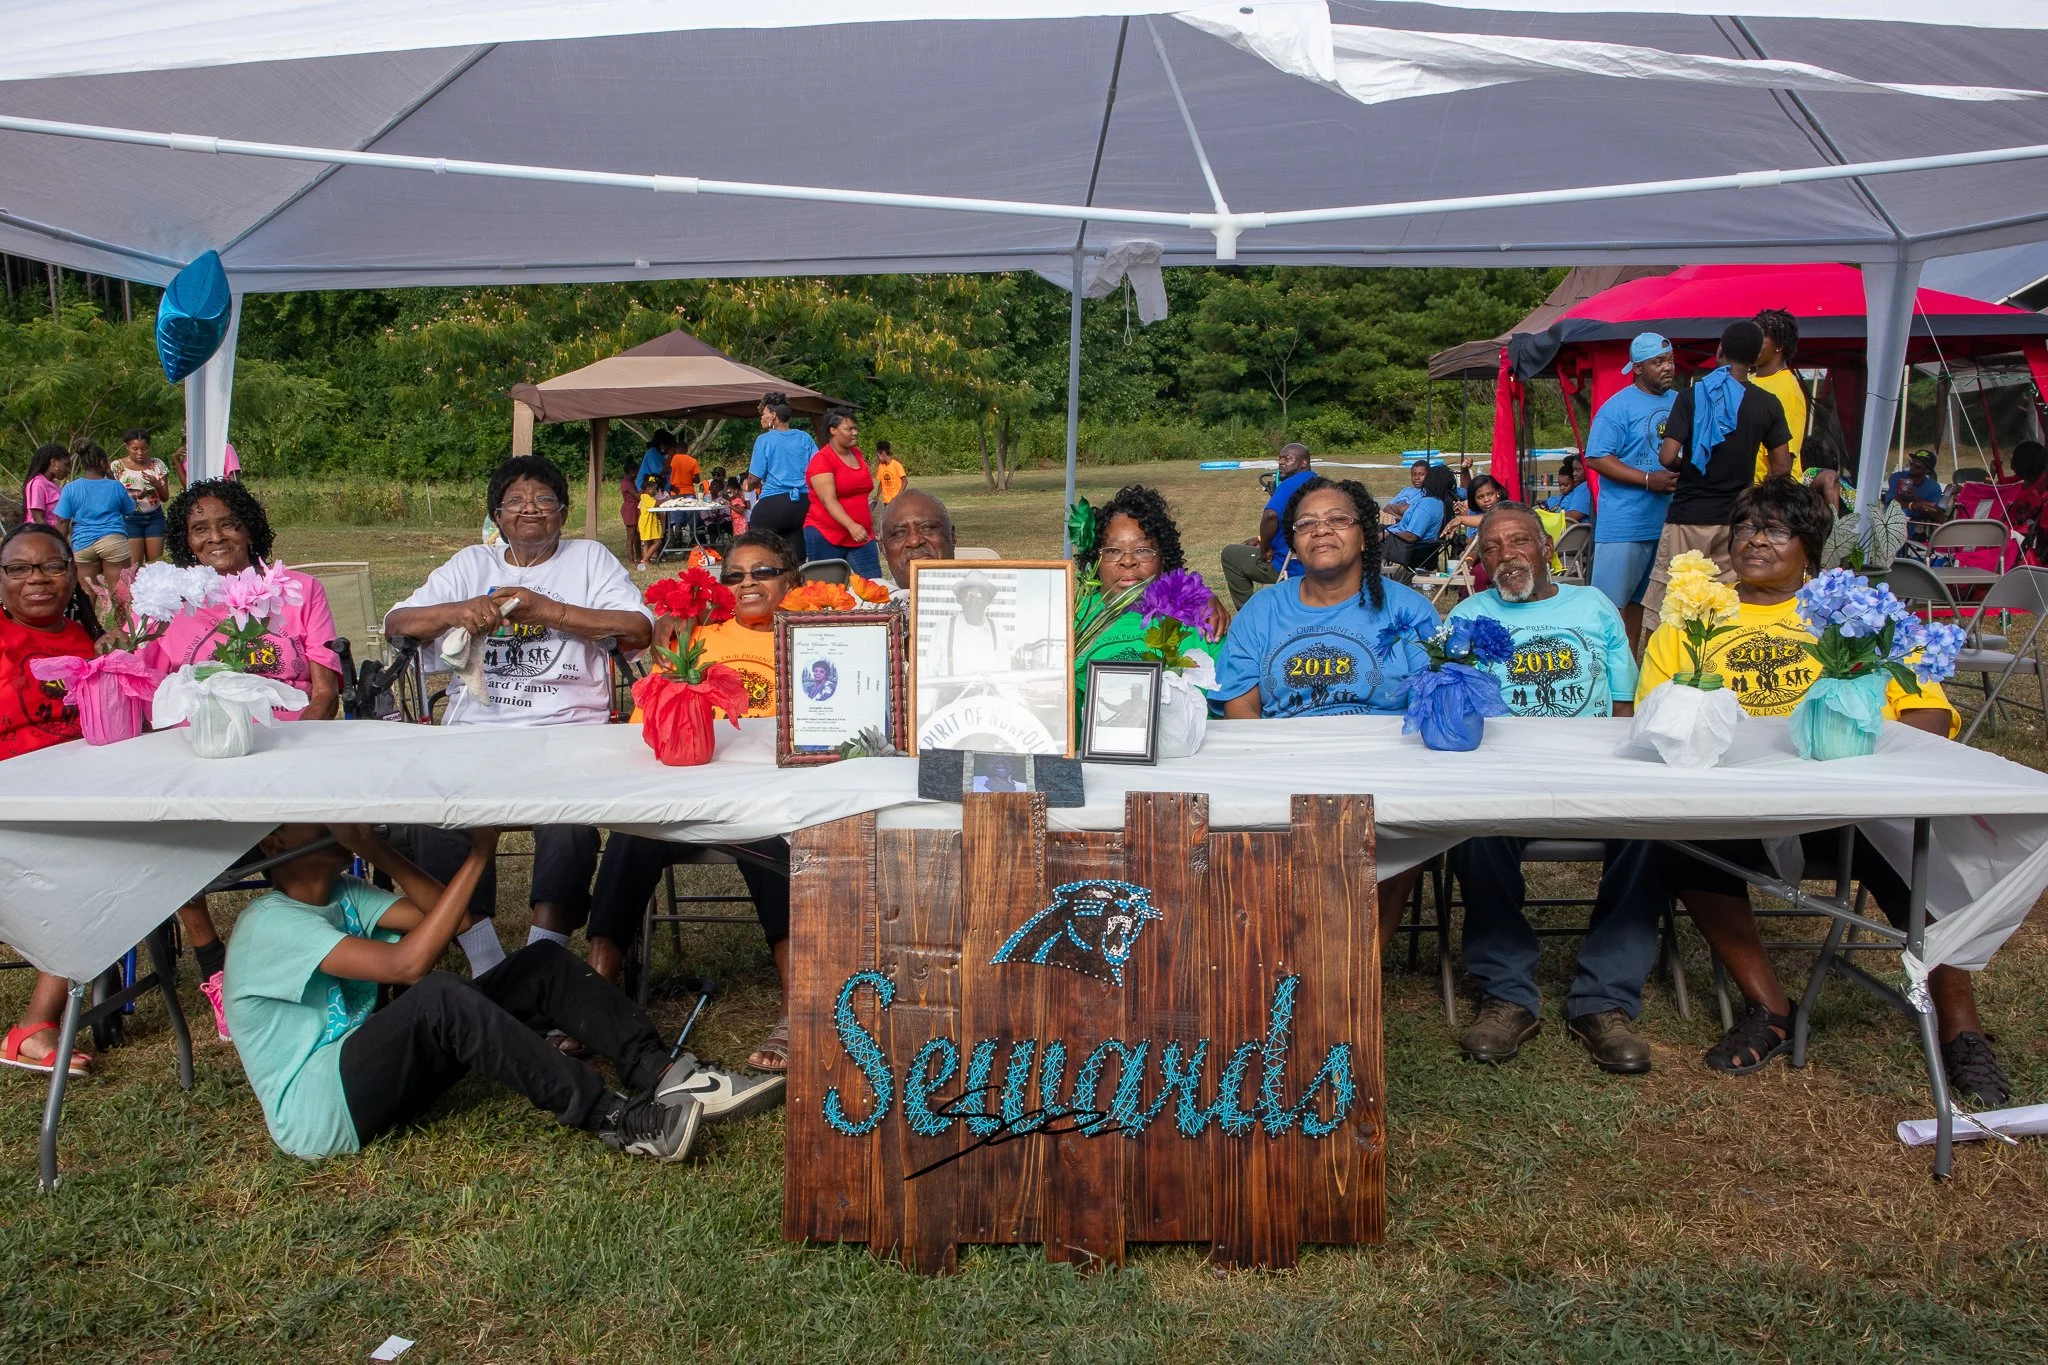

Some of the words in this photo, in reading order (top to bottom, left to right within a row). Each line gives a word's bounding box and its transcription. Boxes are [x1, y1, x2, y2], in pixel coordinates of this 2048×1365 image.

[562, 663, 579, 672] est.
[1289, 657, 1350, 677] 2018
[1513, 648, 1574, 674] 2018
[487, 680, 510, 690] ard
[514, 681, 560, 695] Family
[488, 694, 533, 708] eunion
[922, 712, 961, 749] PIRIT
[964, 706, 983, 727] OF
[822, 967, 1356, 1138] Sewards
